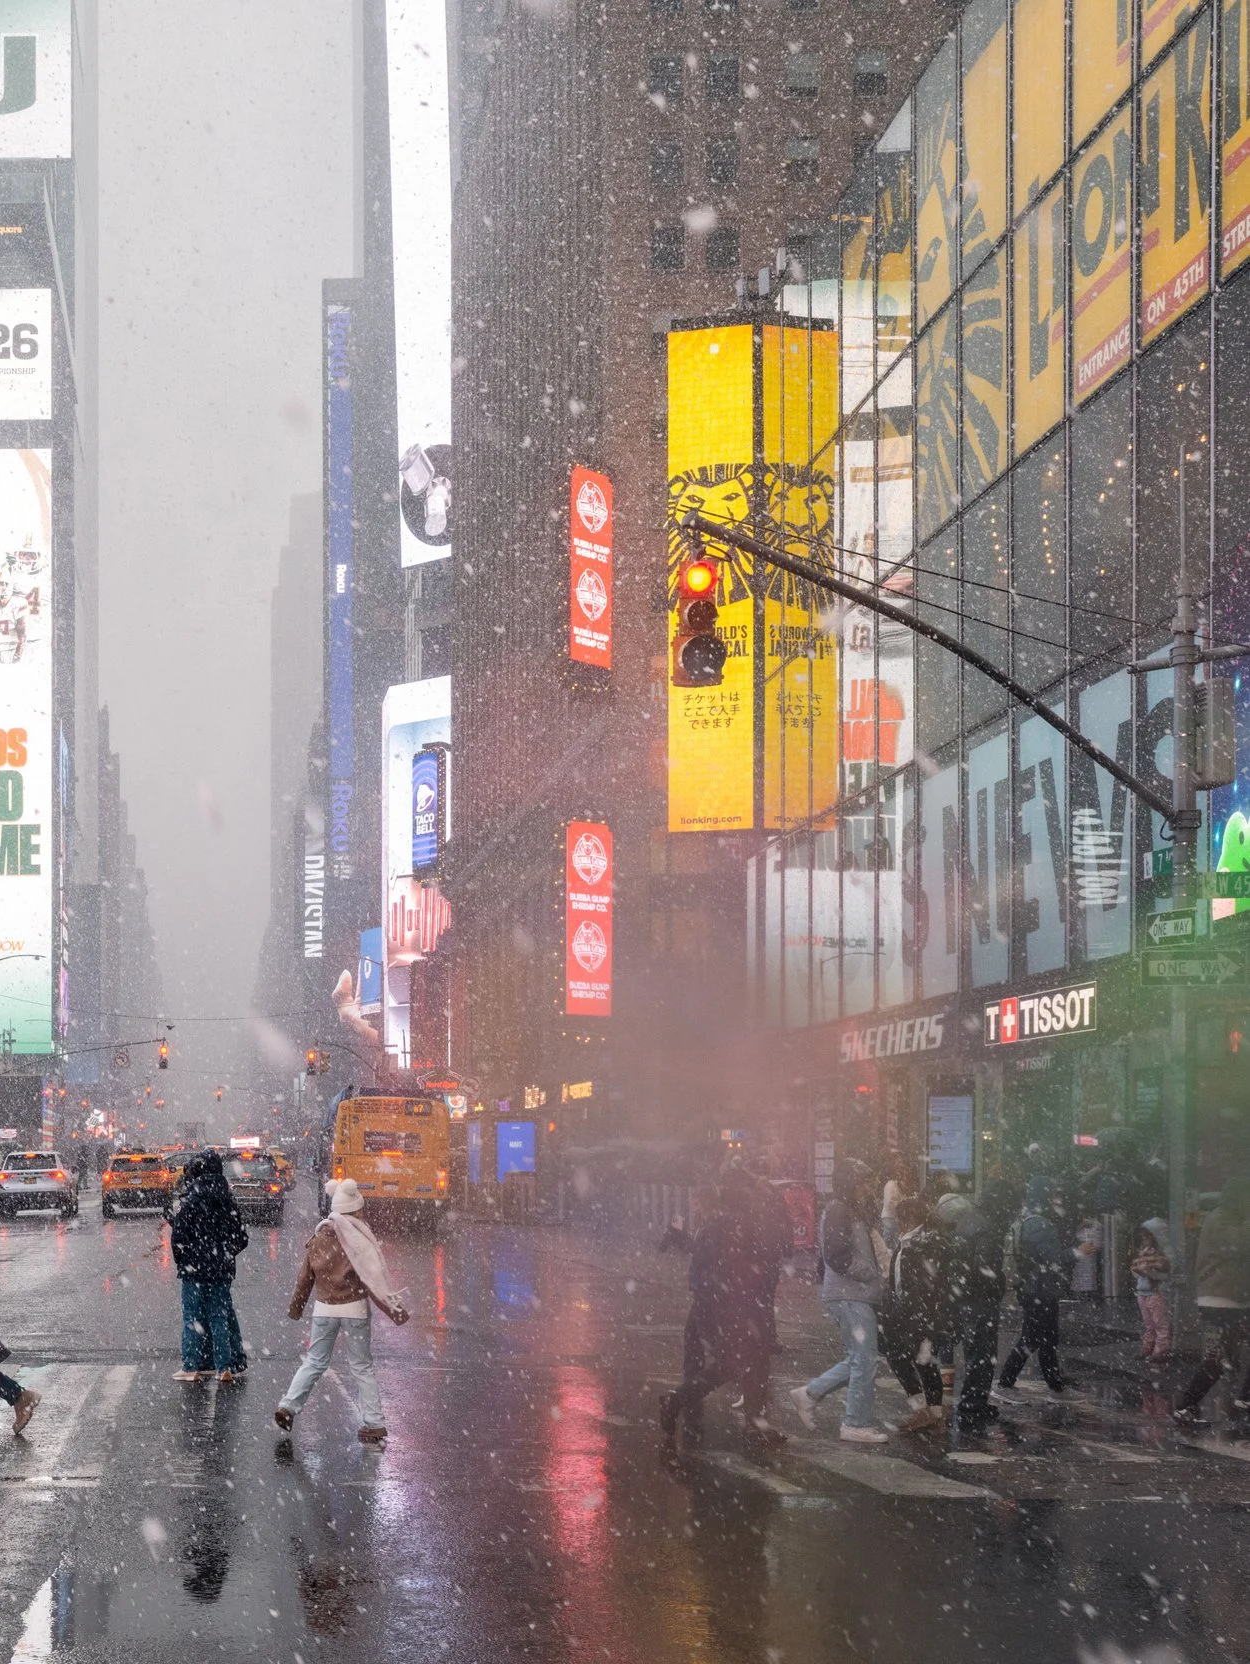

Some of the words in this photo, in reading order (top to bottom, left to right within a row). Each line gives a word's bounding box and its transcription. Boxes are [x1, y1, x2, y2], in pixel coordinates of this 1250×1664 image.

[1077, 324, 1130, 387] ENTRANCE
[1147, 301, 1166, 325] ON
[1173, 256, 1205, 300] 45TH
[573, 537, 593, 550] BUBBA
[593, 542, 610, 555] GUMP
[575, 547, 596, 560] SHRIMP
[573, 625, 593, 639] BUBBA
[592, 631, 610, 643] GUMP
[575, 635, 596, 648] SHRIMP
[683, 690, 741, 705] チケットは
[683, 704, 741, 718] ここで入手
[688, 717, 735, 730] できます
[415, 812, 435, 825] TACO
[680, 815, 742, 825] lionking.com
[416, 822, 436, 835] BELL
[1158, 853, 1163, 872] 7
[1219, 875, 1229, 894] W
[569, 892, 591, 901] BUBBA
[591, 895, 611, 904] GUMP
[572, 901, 595, 911] SHRIMP
[1153, 922, 1167, 937] ONE
[1174, 918, 1189, 933] WAY
[1157, 962, 1187, 976] ONE
[1201, 960, 1230, 975] WAY
[569, 981, 591, 990] BUBBA
[591, 982, 610, 991] GUMP
[571, 990, 595, 999] SHRIMP
[1019, 987, 1095, 1036] TISSOT
[839, 1013, 945, 1064] SKECHERS
